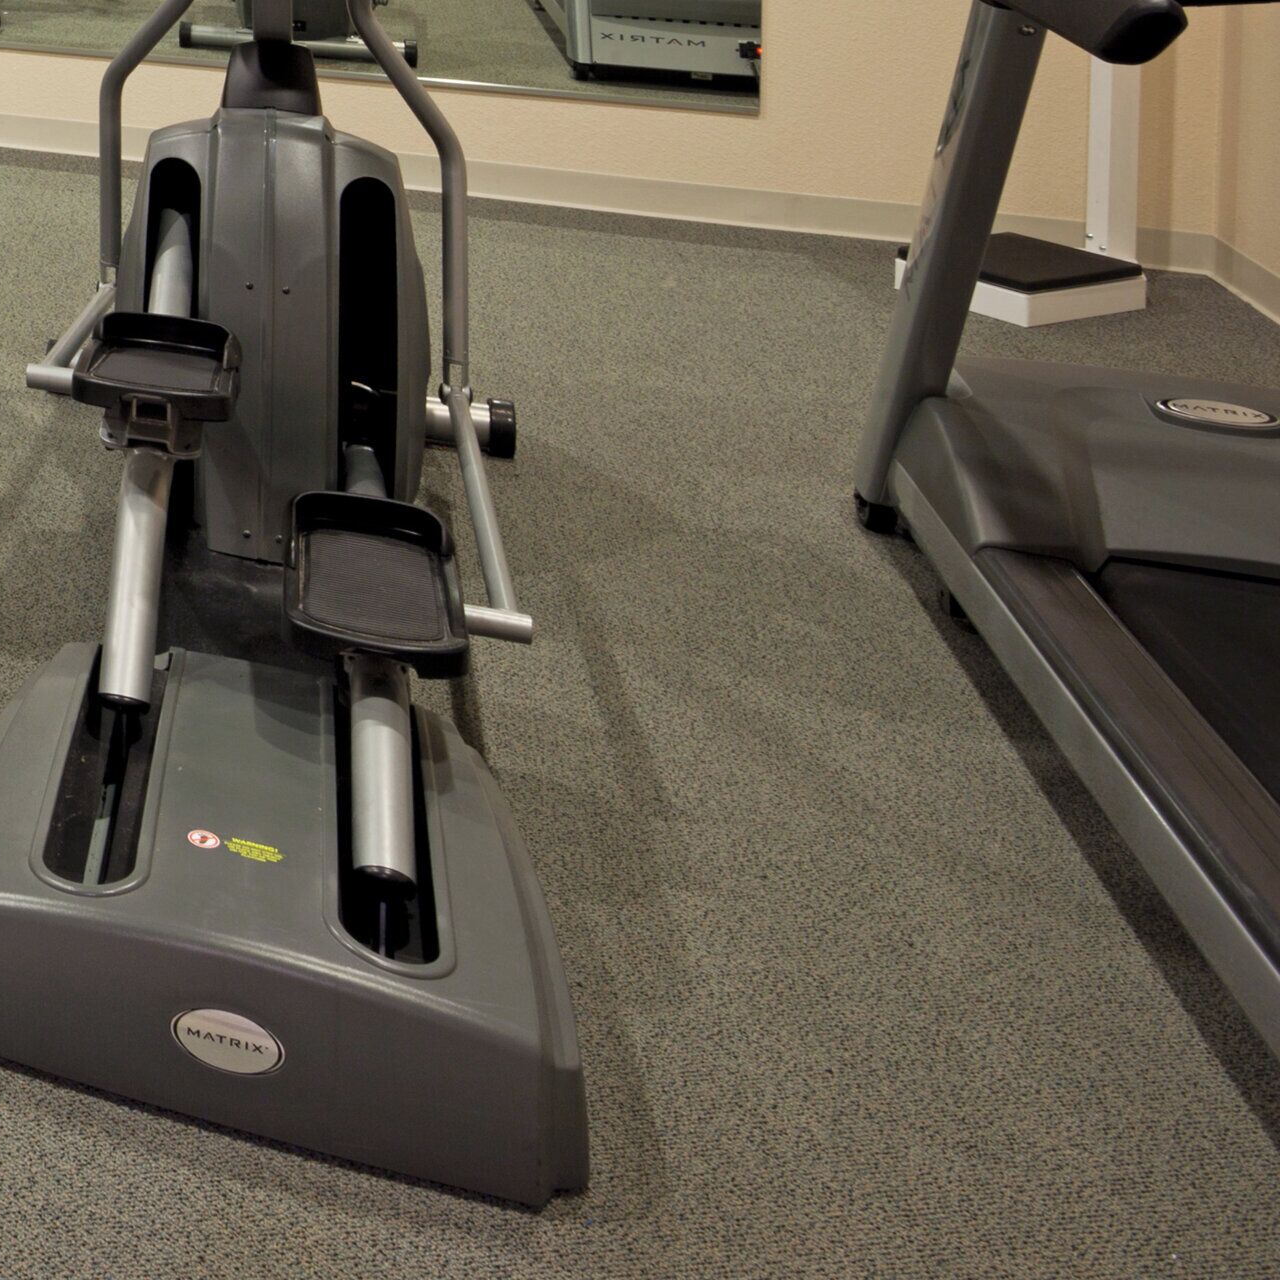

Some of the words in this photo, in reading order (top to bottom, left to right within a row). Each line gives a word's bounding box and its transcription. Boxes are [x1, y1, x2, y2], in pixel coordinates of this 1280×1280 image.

[1172, 402, 1265, 420] MATRIX
[231, 837, 278, 853] WARNING!
[186, 1026, 265, 1055] MATRIX
